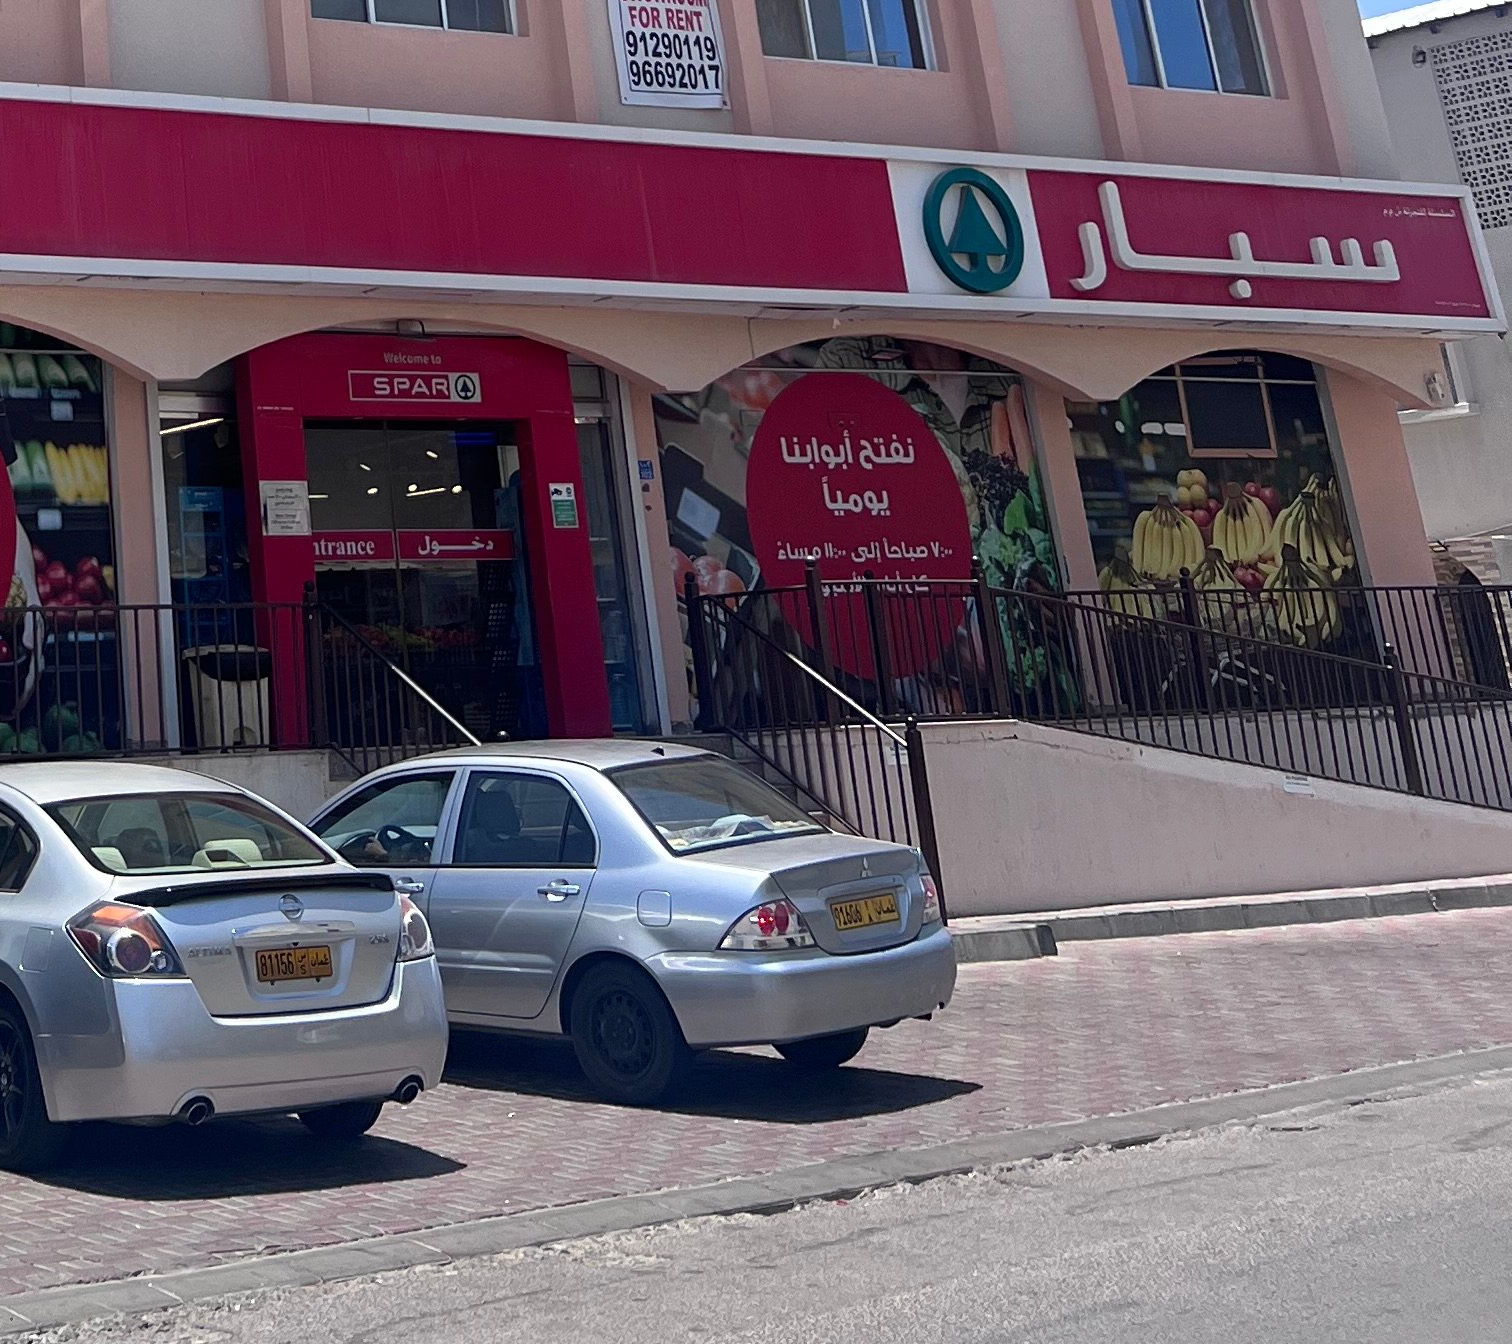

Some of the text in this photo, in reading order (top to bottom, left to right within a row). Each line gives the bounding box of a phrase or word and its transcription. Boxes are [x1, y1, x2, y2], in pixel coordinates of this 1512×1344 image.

[628, 6, 703, 32] FOR RENT
[625, 30, 716, 61] 91290119
[629, 60, 720, 89] 96692017
[1069, 179, 1401, 299] سبار
[383, 352, 442, 365] Welcome to
[373, 377, 449, 396] SPAR
[779, 429, 915, 470] نفتح أبوابنا
[821, 475, 891, 517] يومياً
[312, 538, 375, 556] ntrance
[417, 535, 494, 556] دخول
[851, 541, 881, 563] إلى
[259, 953, 295, 977] 81156
[310, 953, 330, 968] عمان
[300, 964, 307, 975] S
